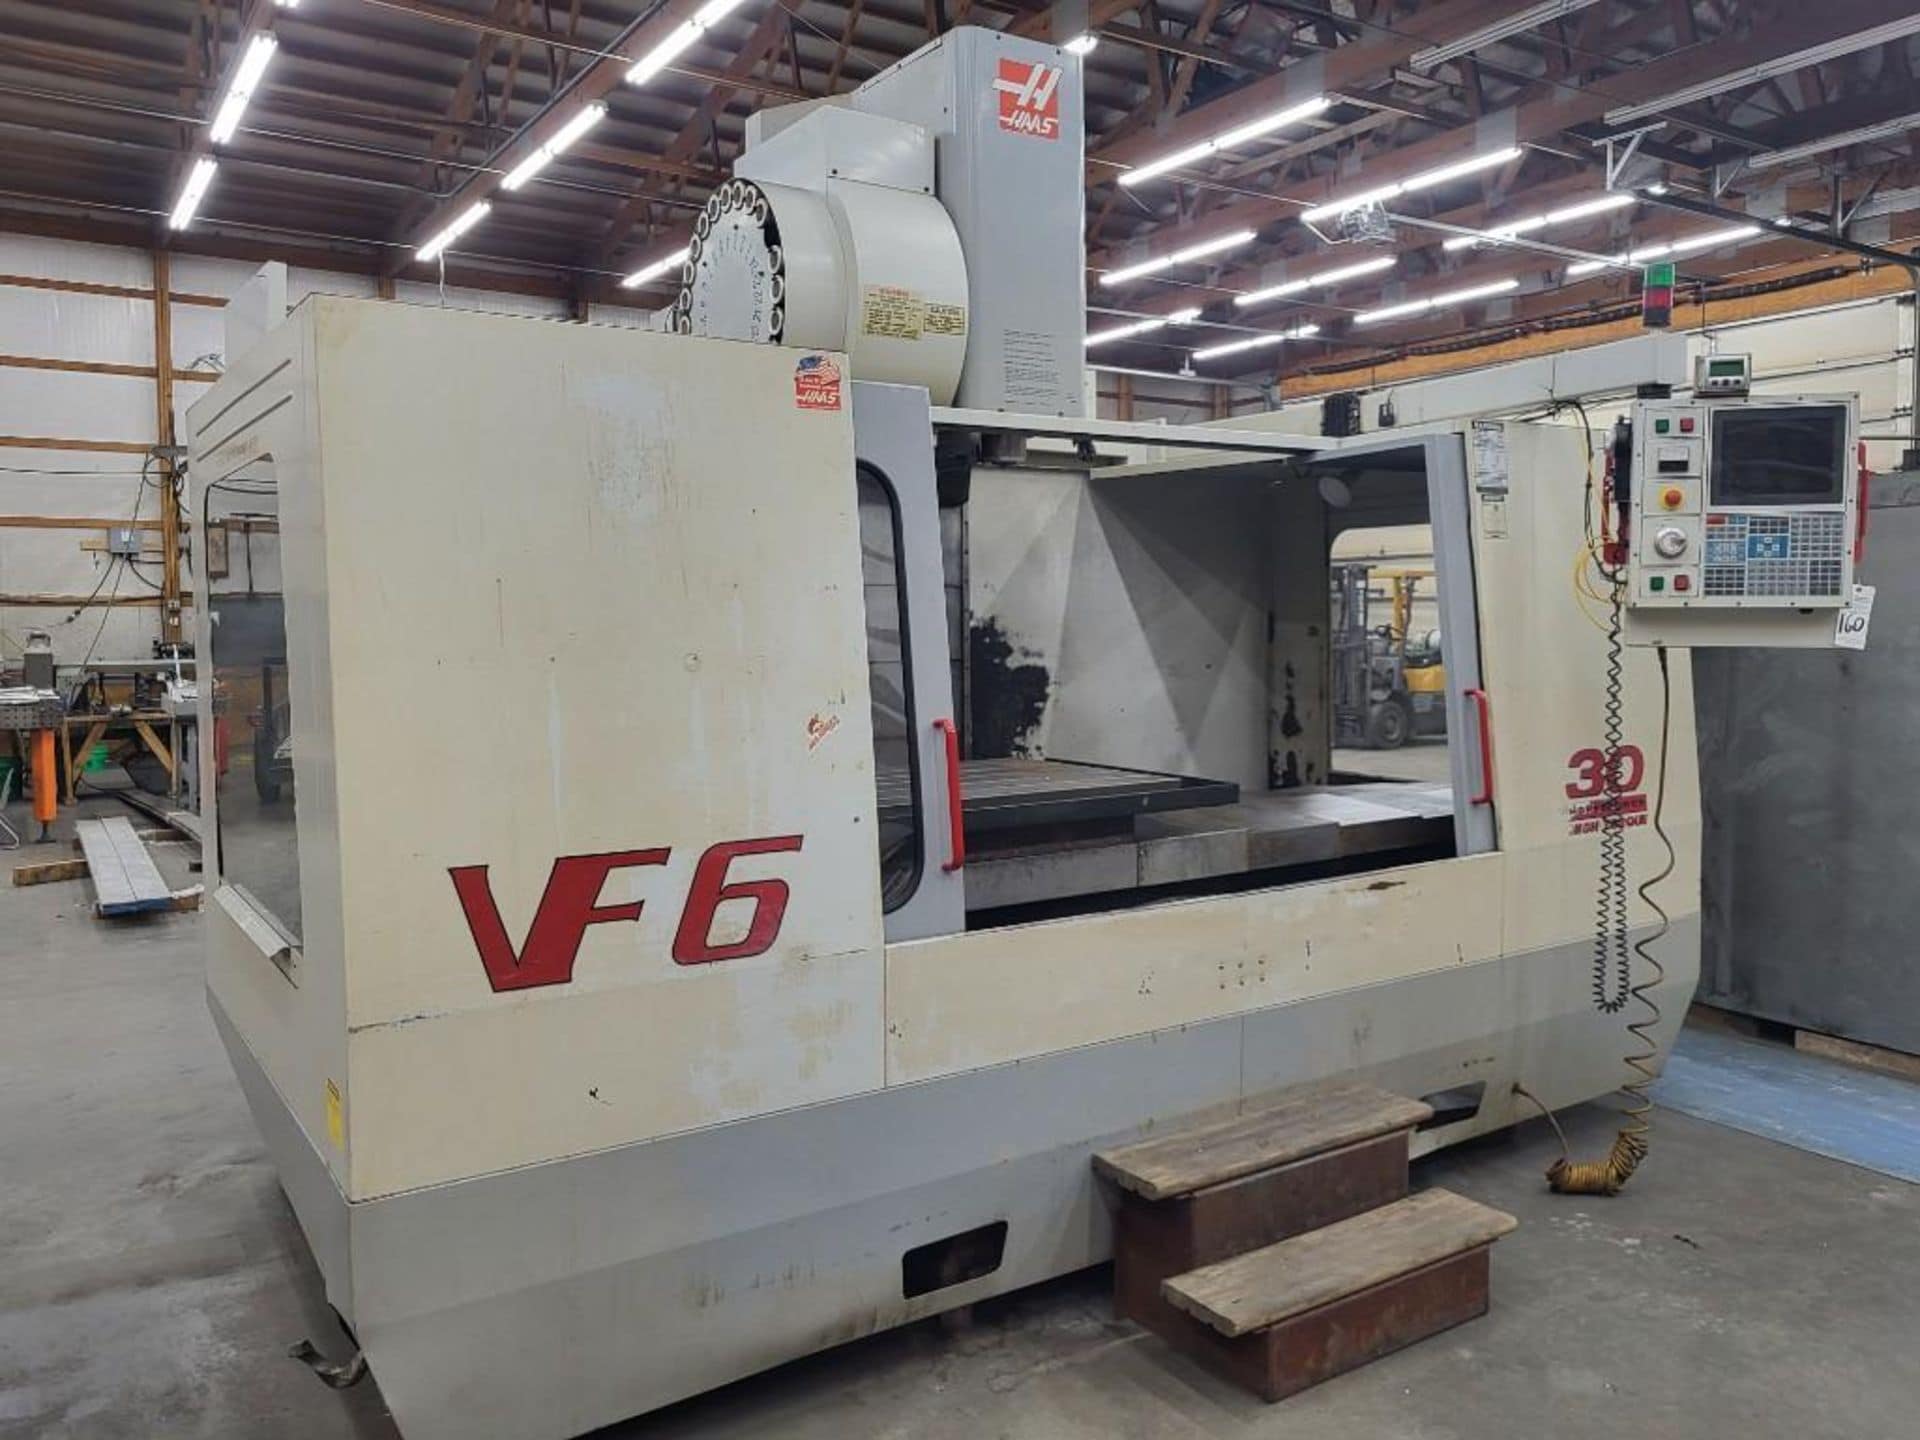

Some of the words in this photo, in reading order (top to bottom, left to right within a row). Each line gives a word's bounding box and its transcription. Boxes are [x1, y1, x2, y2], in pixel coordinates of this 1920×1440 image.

[1000, 109, 1059, 135] HAAS
[1838, 613, 1865, 634] 160
[1565, 744, 1645, 799] 30
